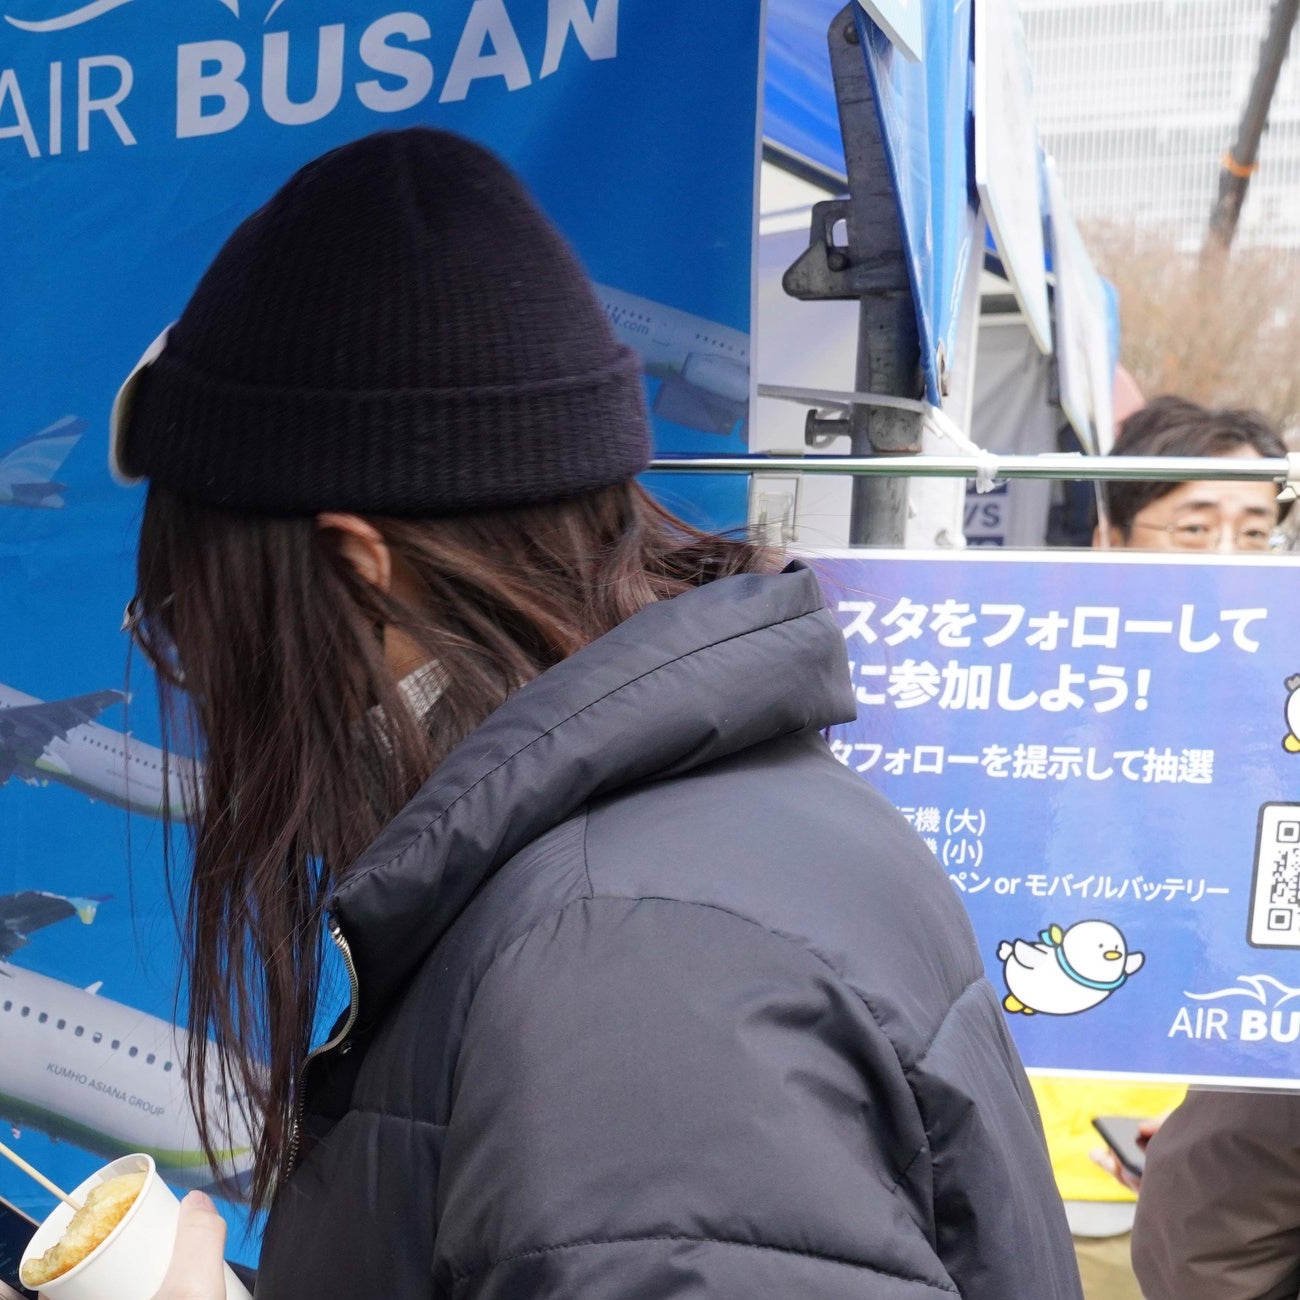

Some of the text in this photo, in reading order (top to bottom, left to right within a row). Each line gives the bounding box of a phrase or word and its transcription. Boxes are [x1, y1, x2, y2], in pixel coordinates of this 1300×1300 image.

[176, 0, 619, 138] BUSAN
[836, 596, 1268, 654] スタをフォローして
[850, 658, 1152, 714] に参加しよう!
[994, 876, 1021, 895] or
[1025, 873, 1230, 902] モバイルバッテリー
[1167, 1006, 1300, 1043] AIR BU
[46, 1062, 166, 1117] KUMHO ASIANA GROUP
